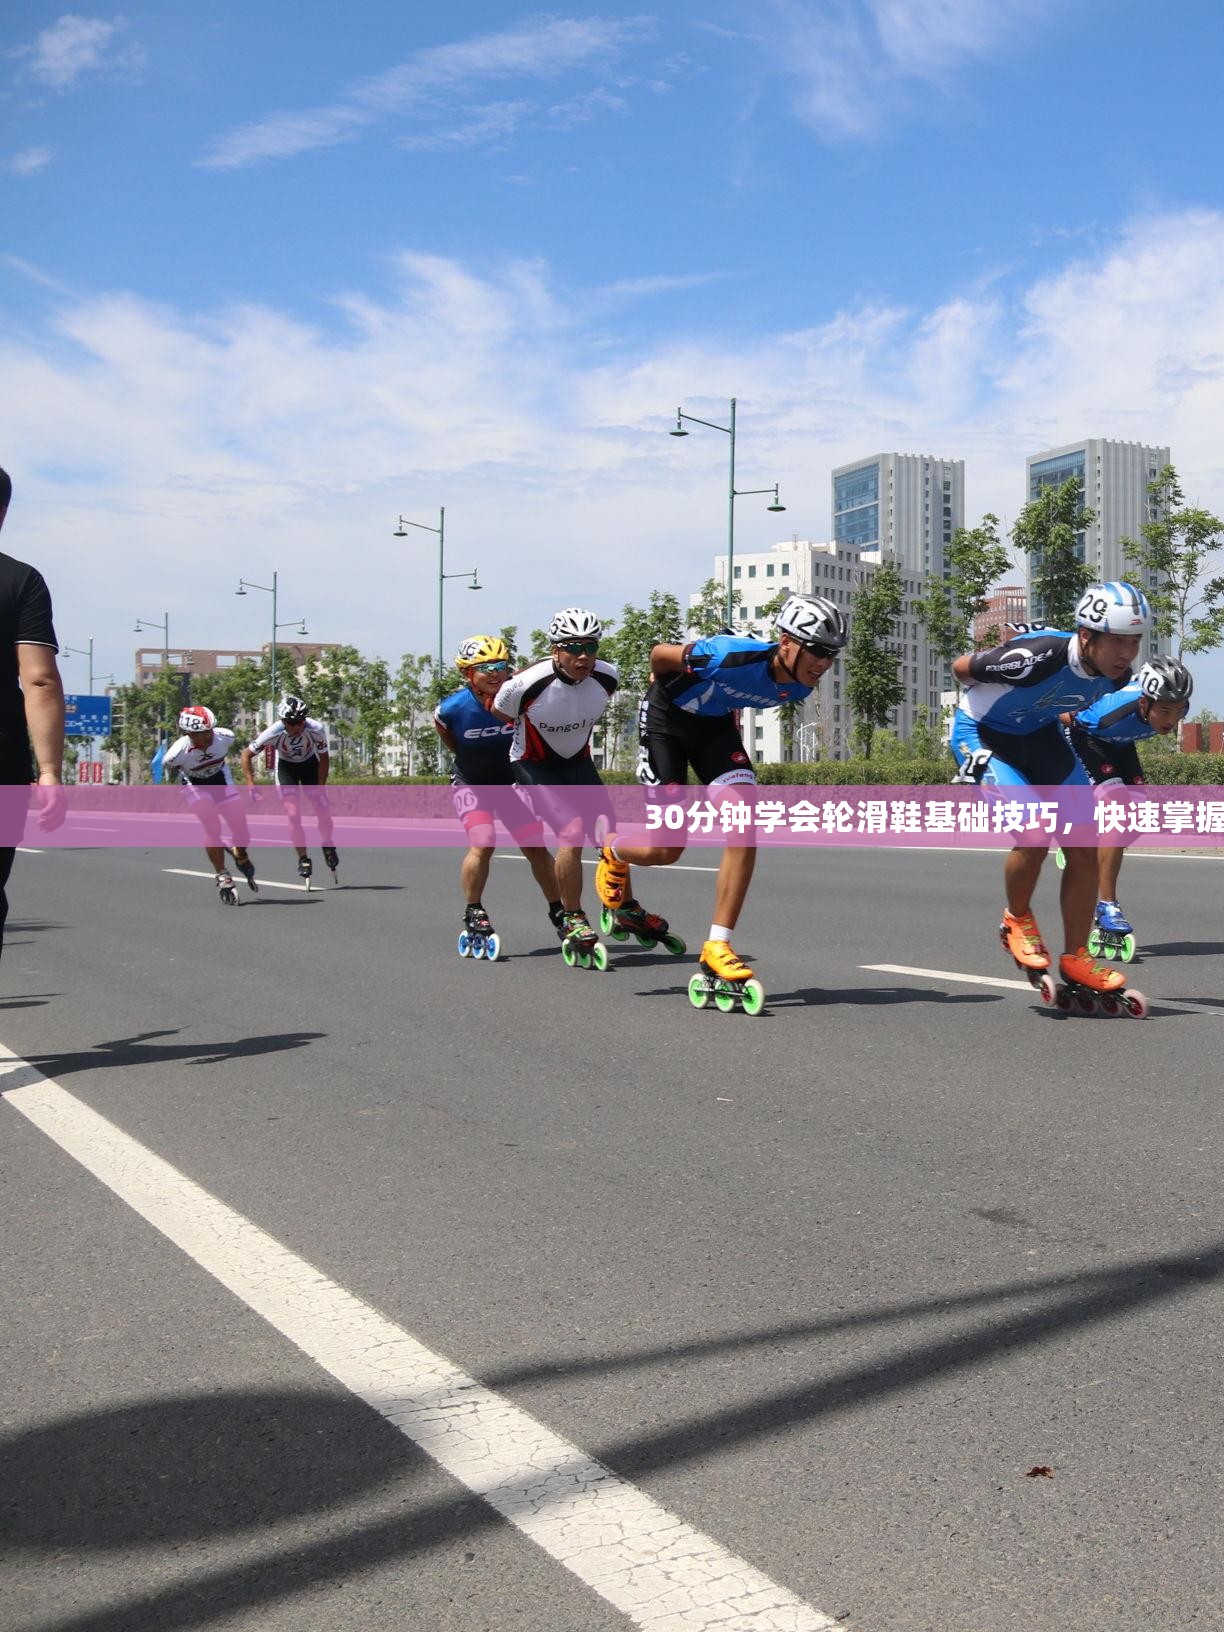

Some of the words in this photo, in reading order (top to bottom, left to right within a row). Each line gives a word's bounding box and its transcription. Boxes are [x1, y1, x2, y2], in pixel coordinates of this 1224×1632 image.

[1078, 594, 1107, 623] 29
[1142, 672, 1159, 695] 10
[185, 717, 201, 730] 18
